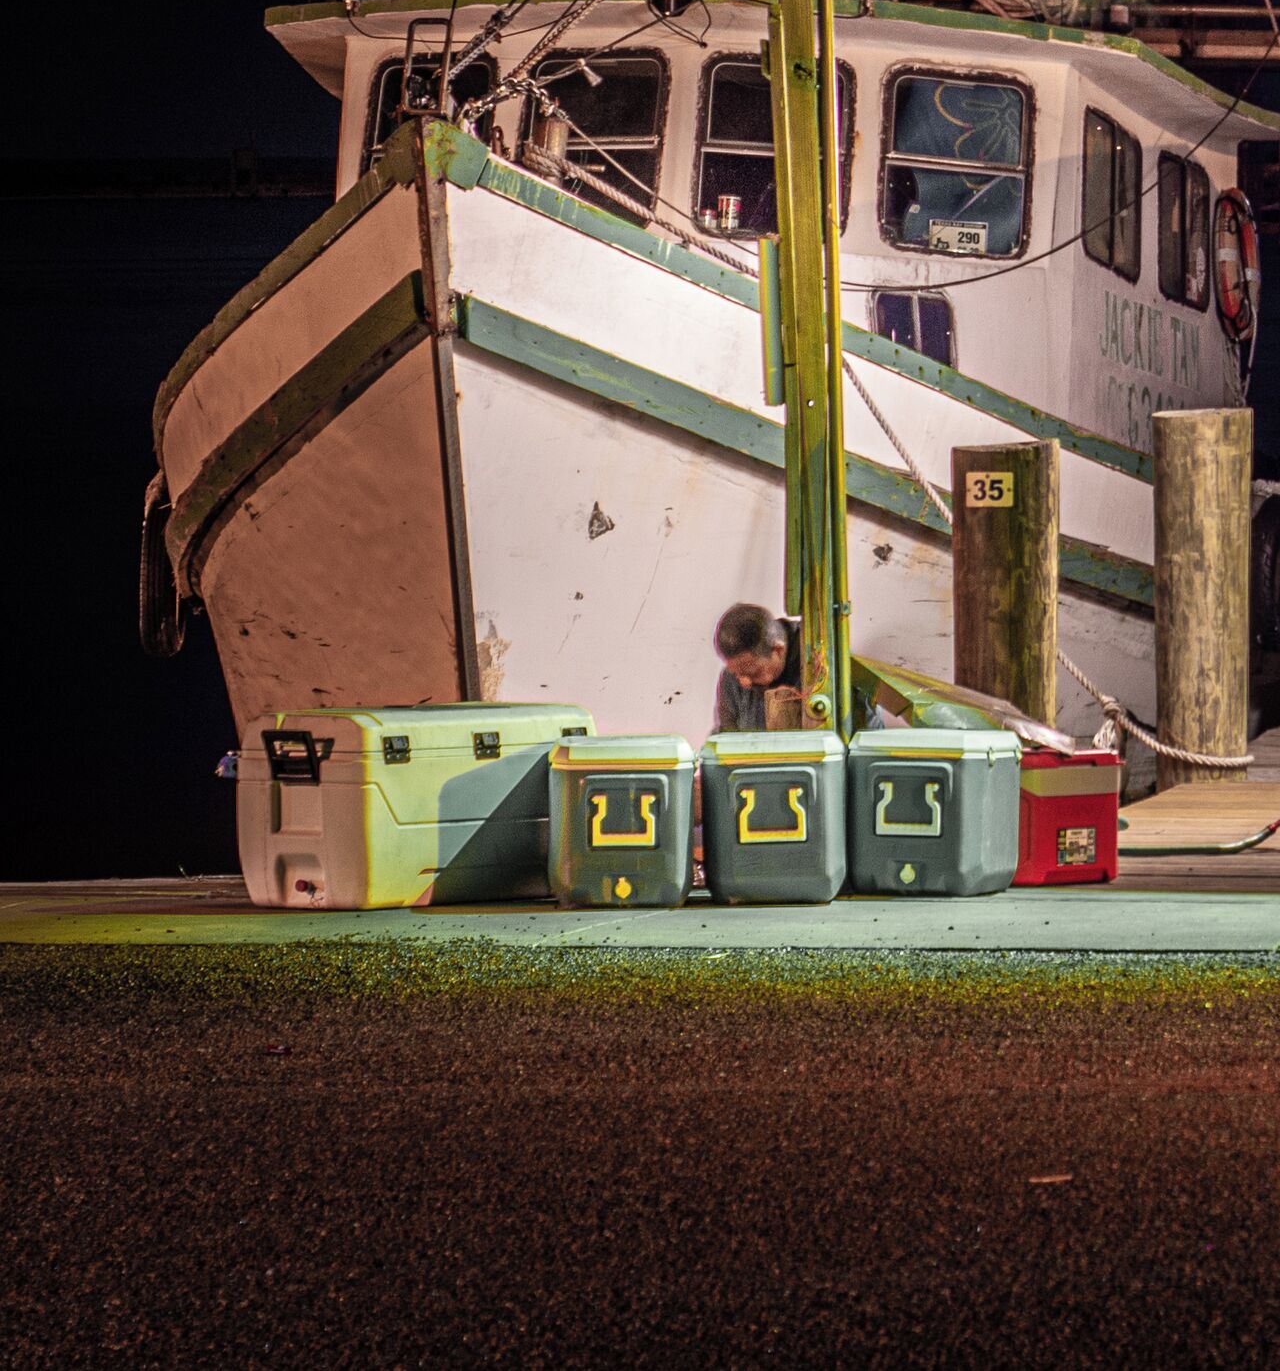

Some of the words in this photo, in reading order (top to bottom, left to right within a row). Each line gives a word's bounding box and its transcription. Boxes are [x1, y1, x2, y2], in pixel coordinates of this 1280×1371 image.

[957, 231, 980, 245] 290
[1099, 290, 1163, 377] JACKIE
[972, 479, 1003, 501] 35
